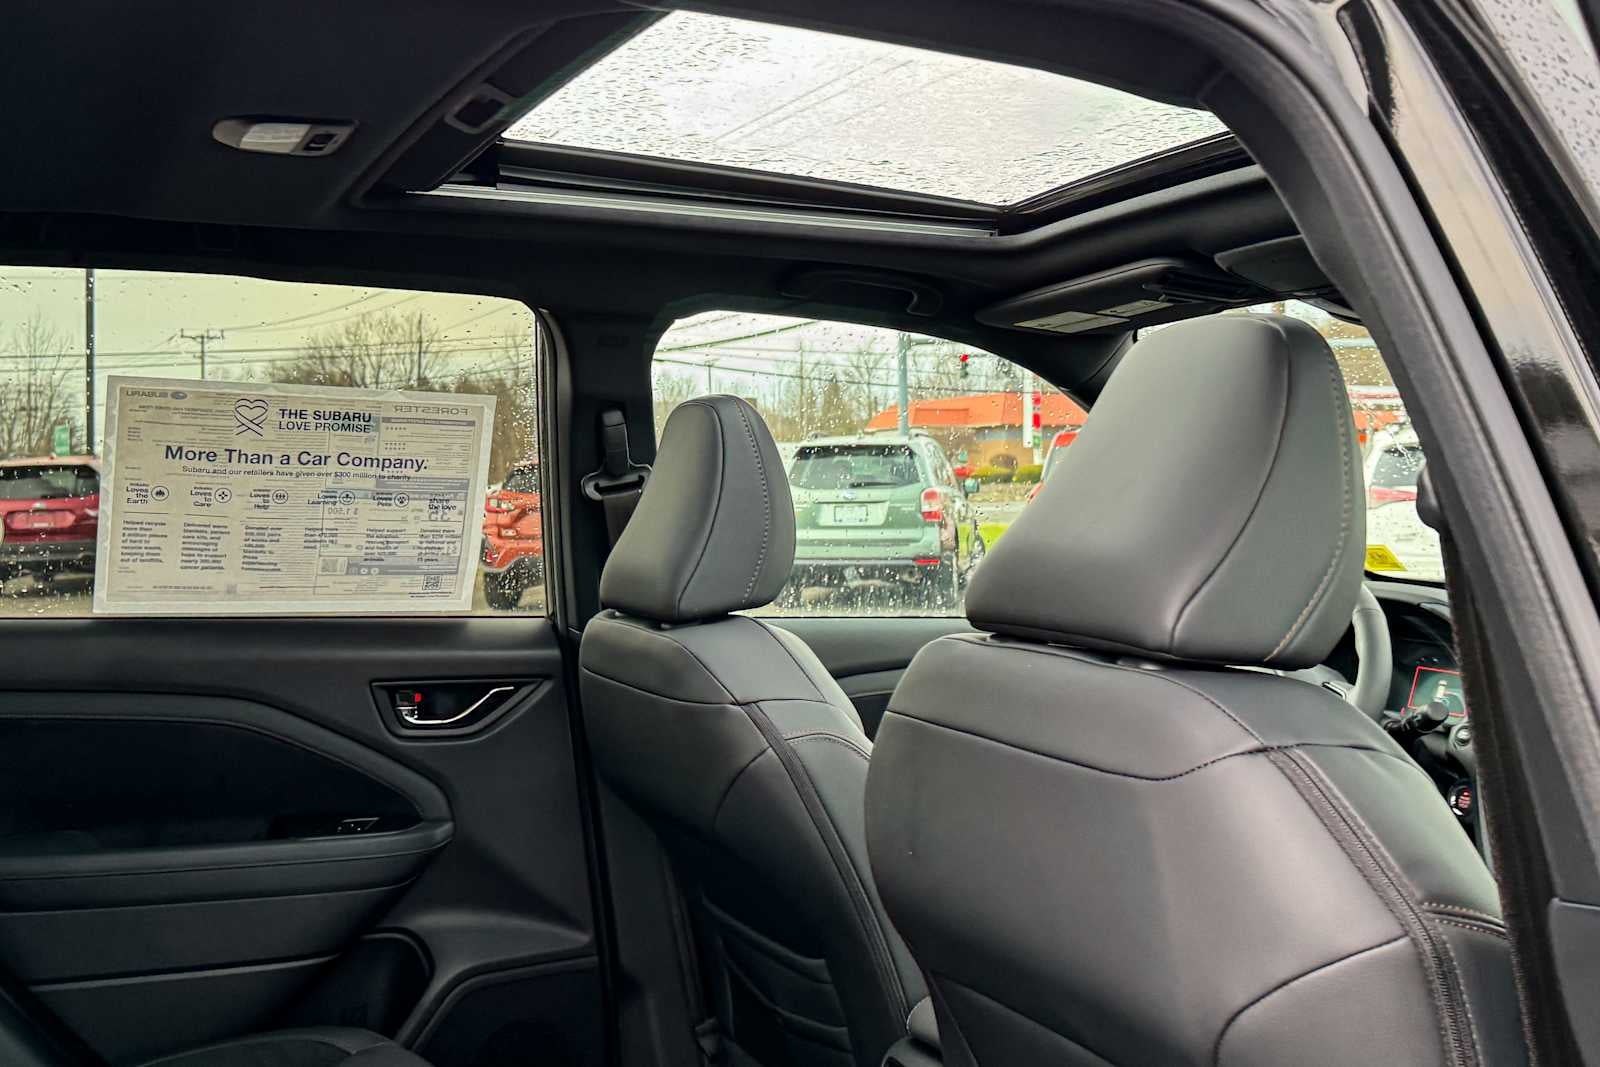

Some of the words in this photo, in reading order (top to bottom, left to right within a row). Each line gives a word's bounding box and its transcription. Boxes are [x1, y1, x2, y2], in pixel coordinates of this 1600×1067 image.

[278, 408, 309, 420] THE
[312, 410, 372, 423] SUBARU
[278, 421, 311, 431] LOVE
[314, 422, 372, 434] PROMISE
[165, 445, 218, 462] More
[224, 448, 273, 465] Than
[279, 454, 291, 465] a
[297, 451, 332, 466] Car
[336, 452, 428, 473] Company.
[182, 465, 211, 474] Subaru
[212, 467, 228, 475] and
[243, 469, 275, 477] retailers
[295, 471, 315, 479] given
[334, 471, 351, 479] $300
[352, 472, 377, 480] million
